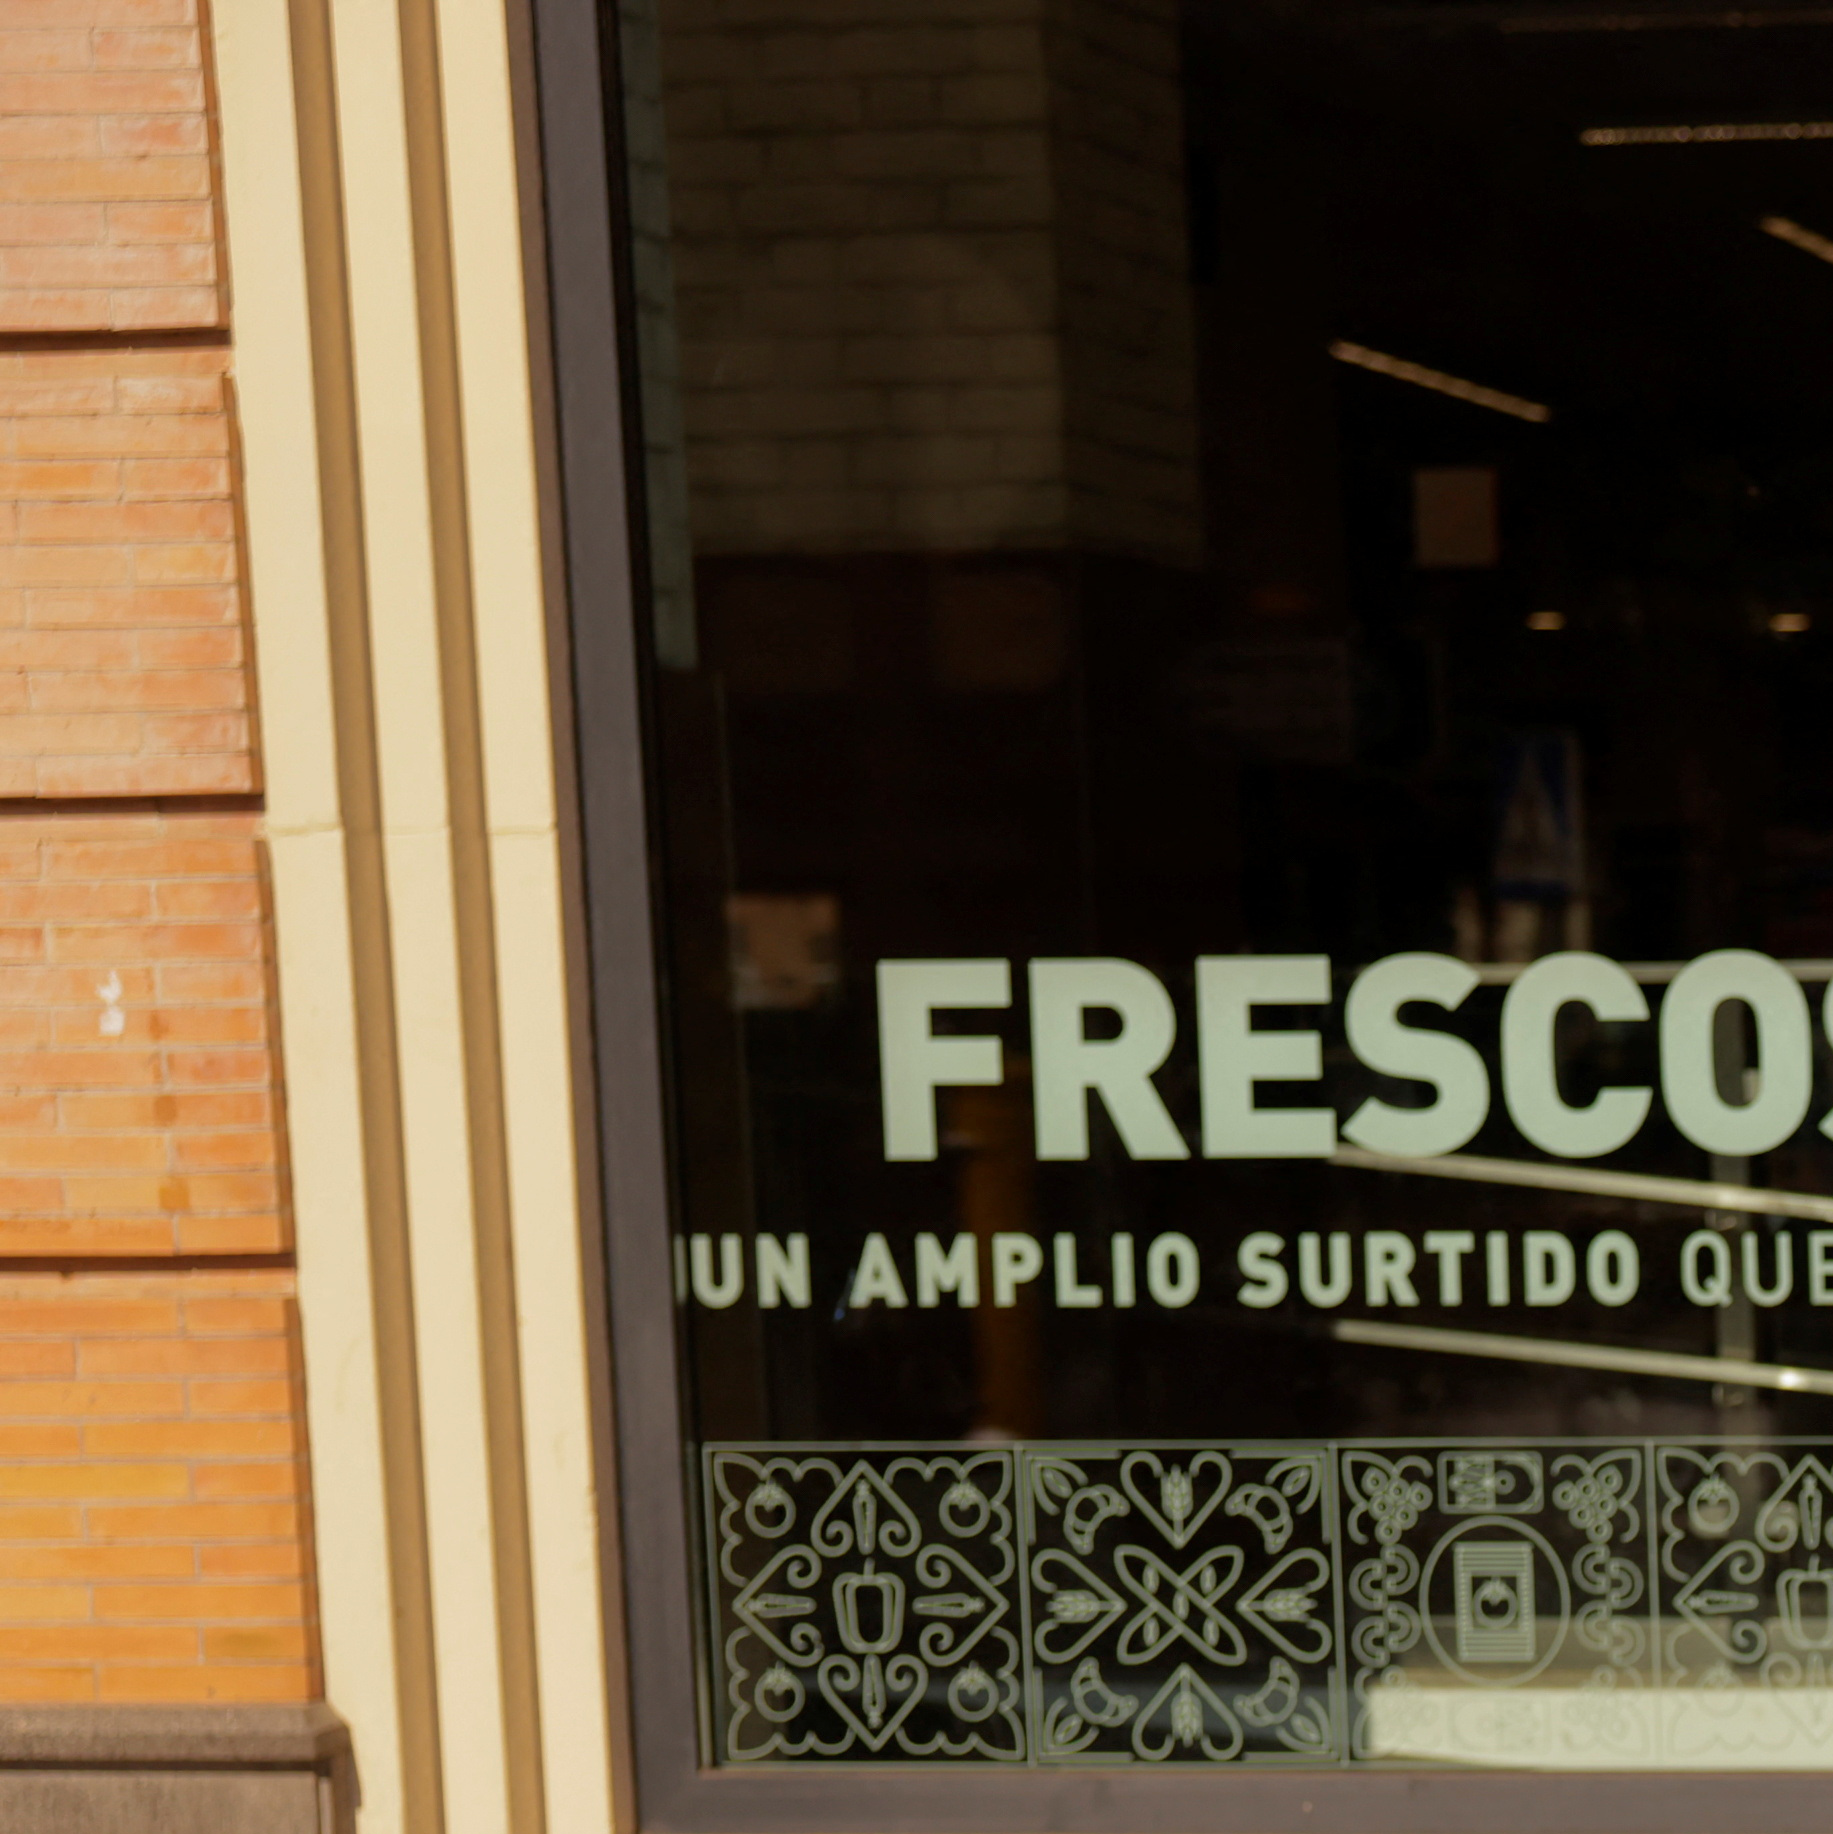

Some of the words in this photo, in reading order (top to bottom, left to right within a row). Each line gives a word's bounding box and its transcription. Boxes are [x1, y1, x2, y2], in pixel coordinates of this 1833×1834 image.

[689, 1232, 813, 1309] UN
[848, 1232, 1200, 1309] AMPLIO
[1236, 1230, 1640, 1309] SURTIDO
